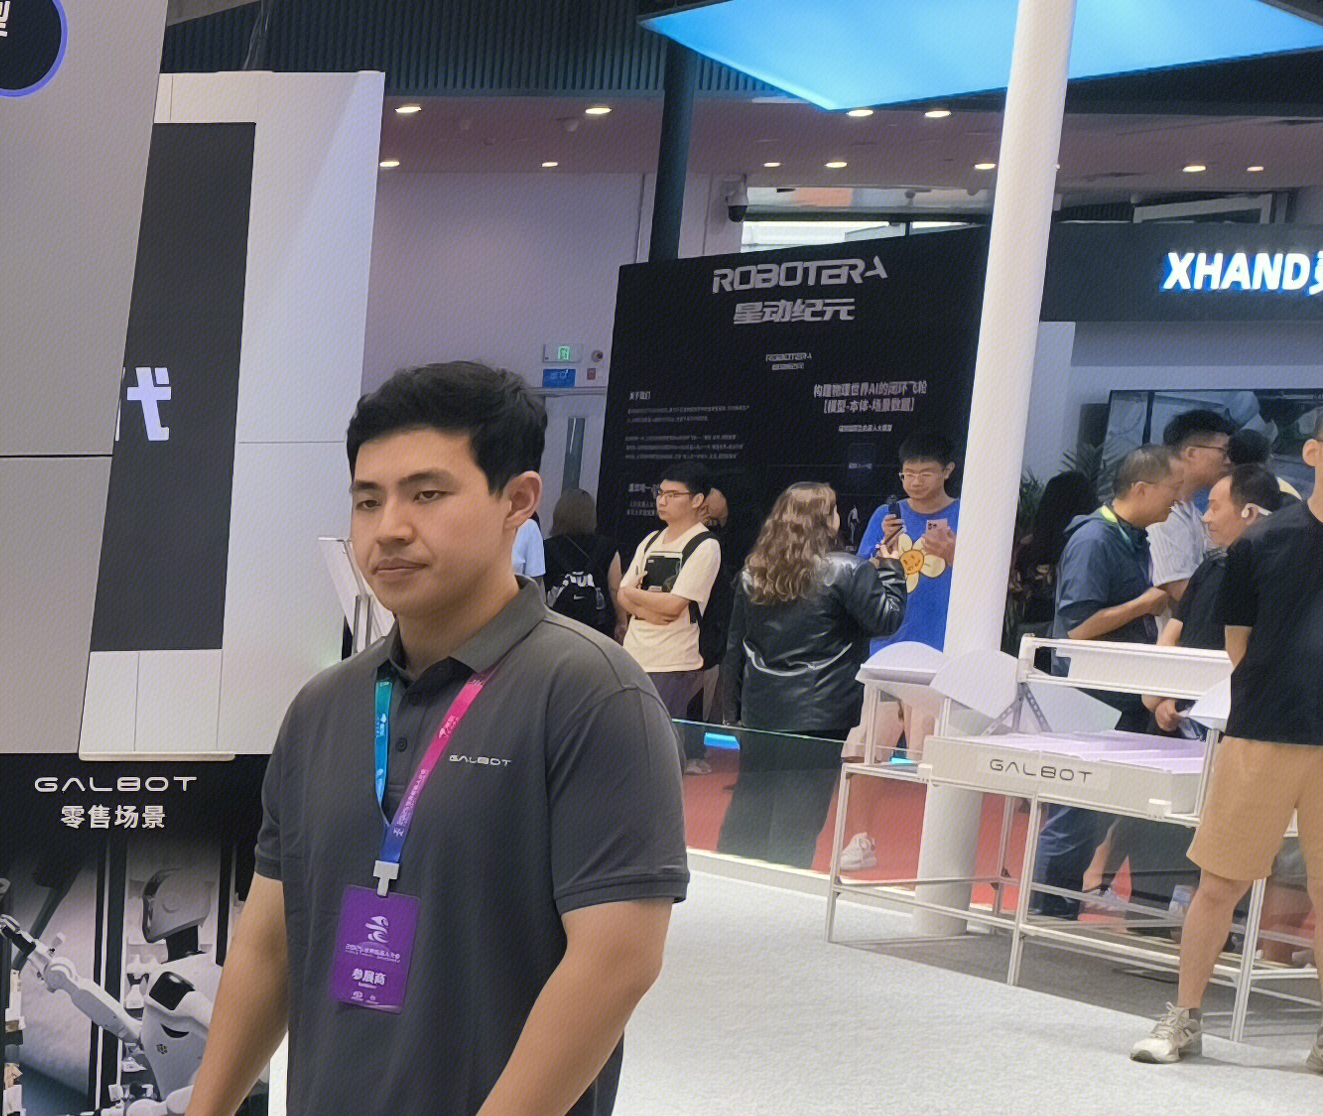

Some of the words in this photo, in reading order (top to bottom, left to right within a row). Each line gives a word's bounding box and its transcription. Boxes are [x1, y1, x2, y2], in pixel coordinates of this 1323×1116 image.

[712, 255, 888, 294] ROBOTERA
[733, 298, 855, 325] 星动纪元
[449, 754, 513, 767] GALBOT
[989, 757, 1094, 785] GALBOT
[33, 775, 198, 794] GALBOT
[59, 804, 167, 830] 零售场景
